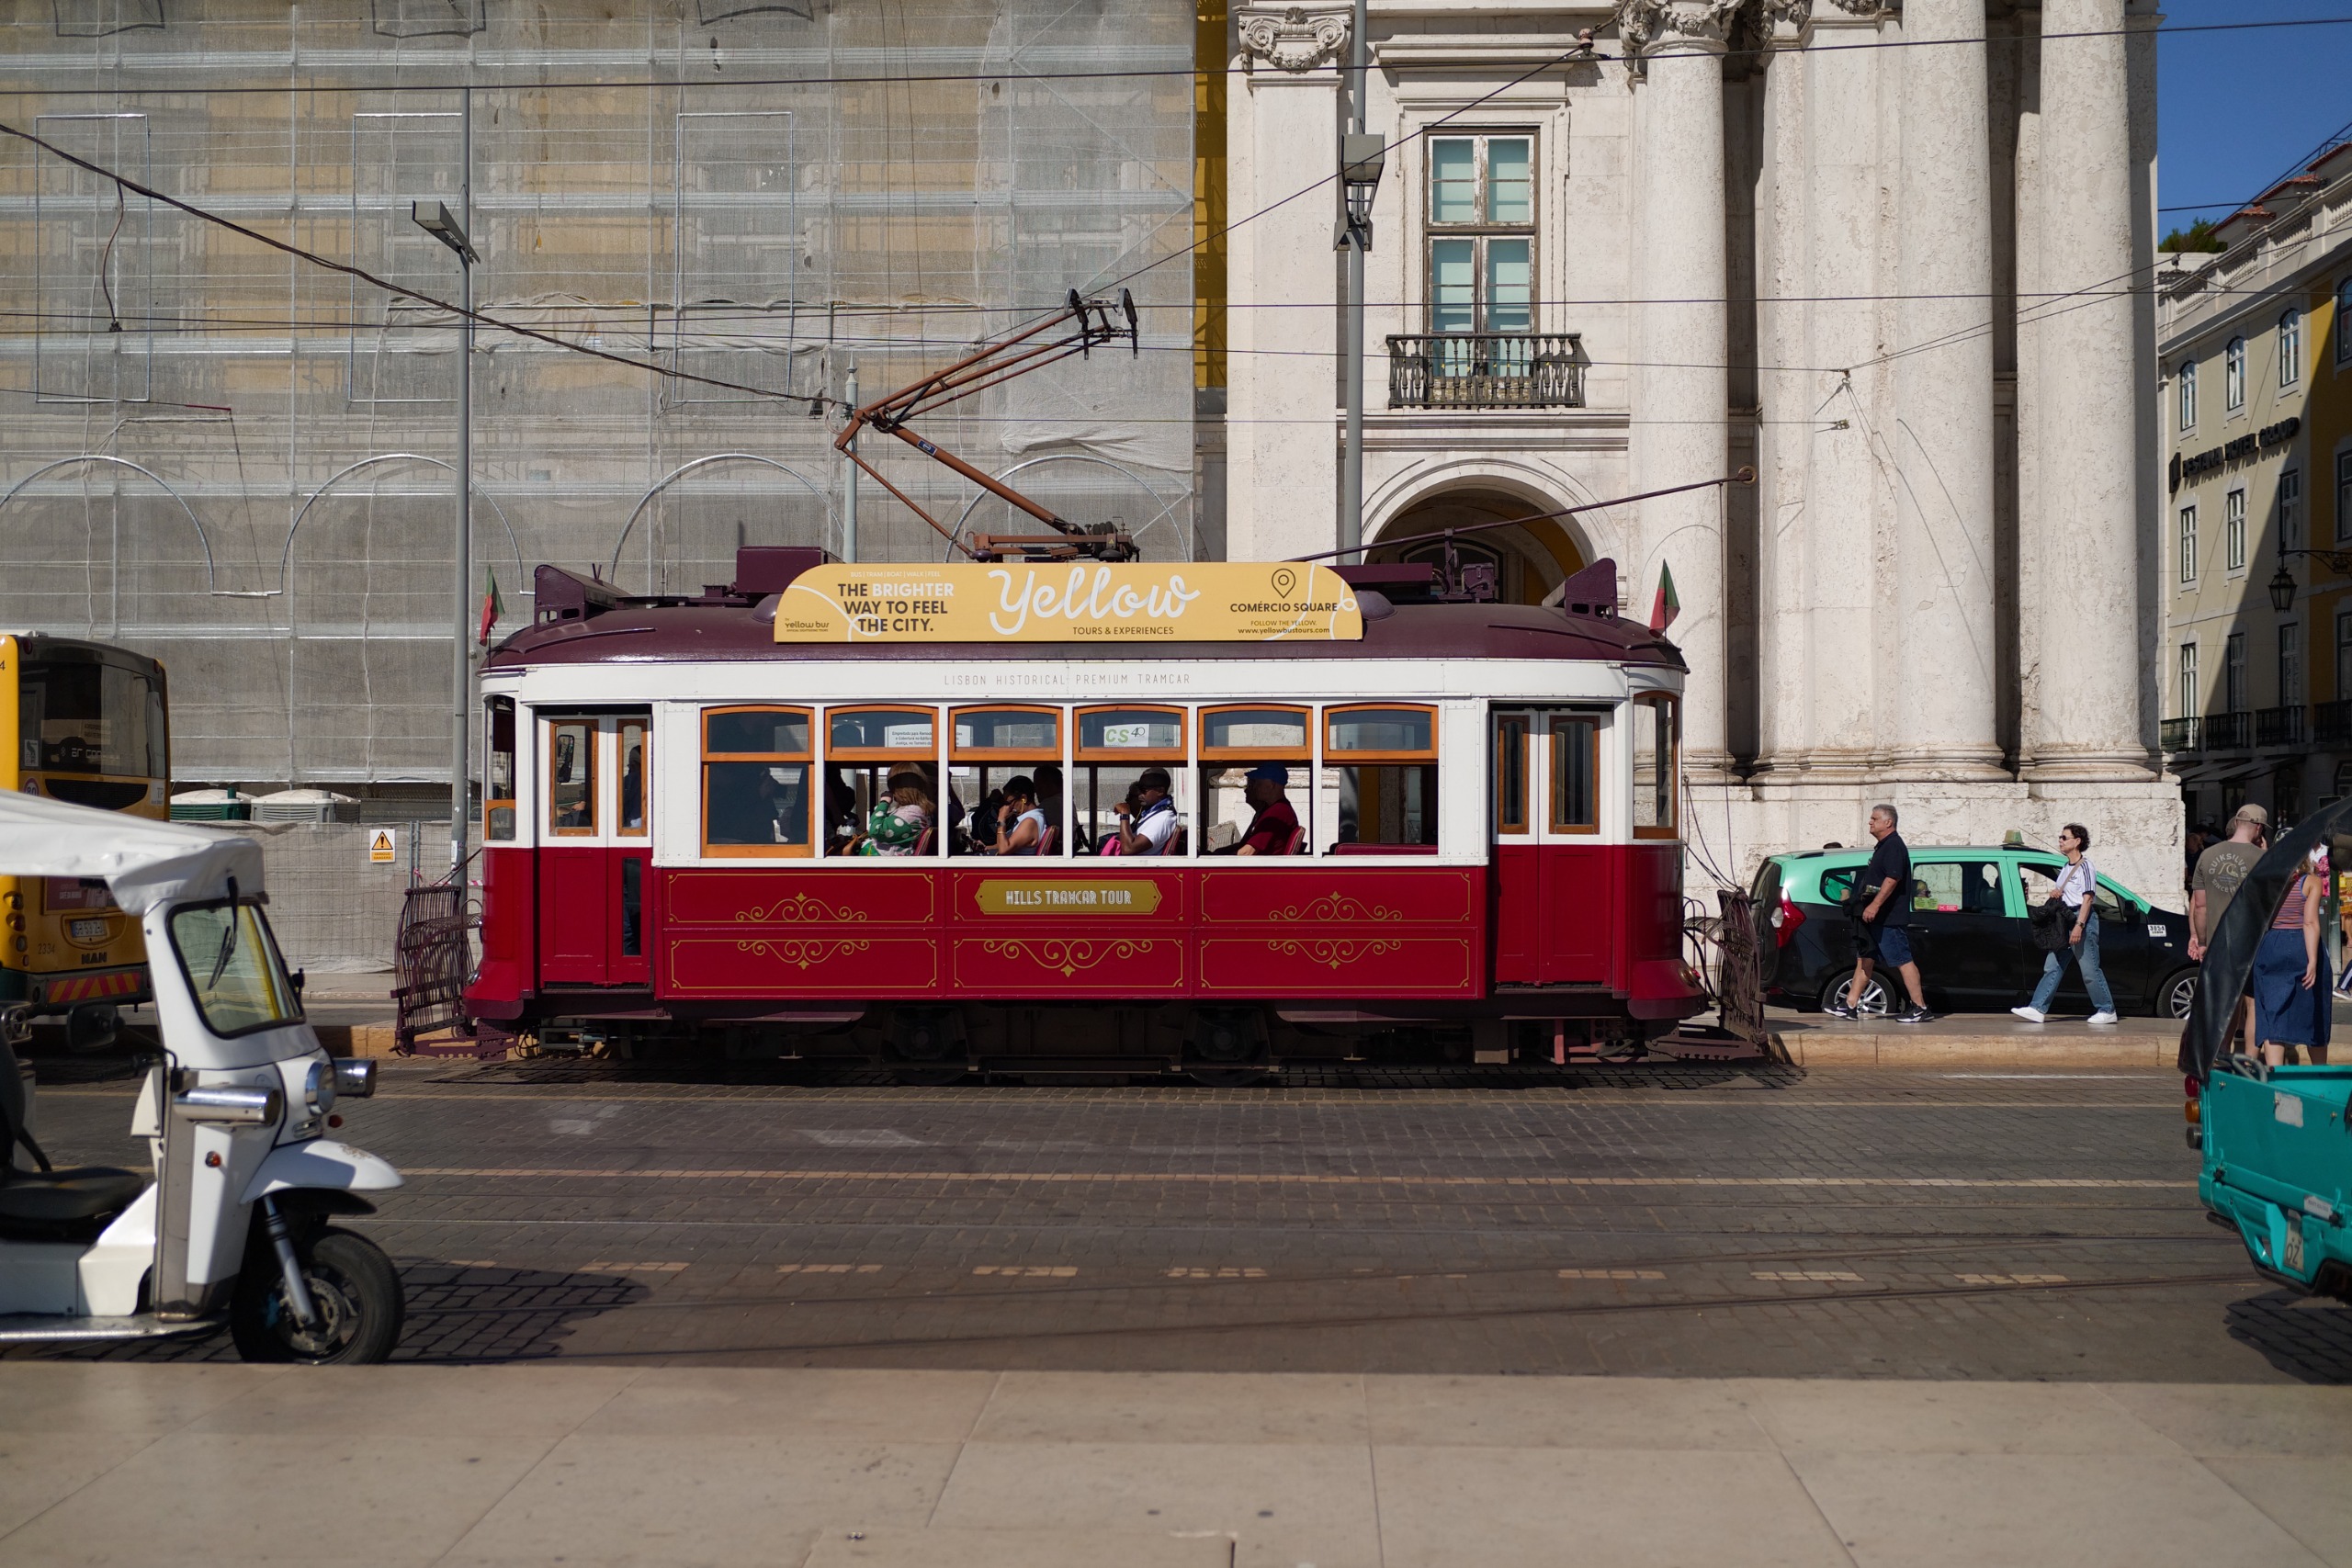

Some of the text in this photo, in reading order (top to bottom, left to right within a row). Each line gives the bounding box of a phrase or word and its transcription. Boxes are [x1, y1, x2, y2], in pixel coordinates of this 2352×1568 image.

[2182, 417, 2300, 478] PESTANA HOTEL GROUP
[838, 583, 955, 597] THE BRIGHTER
[843, 601, 948, 614] WAY TO FEEL
[988, 566, 1201, 636] Yellow
[1230, 601, 1338, 613] COMÉRCIO SQUARE
[858, 618, 933, 632] THE CITY.
[1073, 626, 1174, 635] TOURS & EXPERIENCES
[944, 674, 1190, 685] LISBON HISTORICAL PREMIUM TRAMCAR
[1105, 727, 1145, 743] CS 40
[1005, 890, 1132, 906] HILLS TRAMCAR TOUR
[38, 943, 55, 955] 2334
[81, 952, 107, 964] MAN
